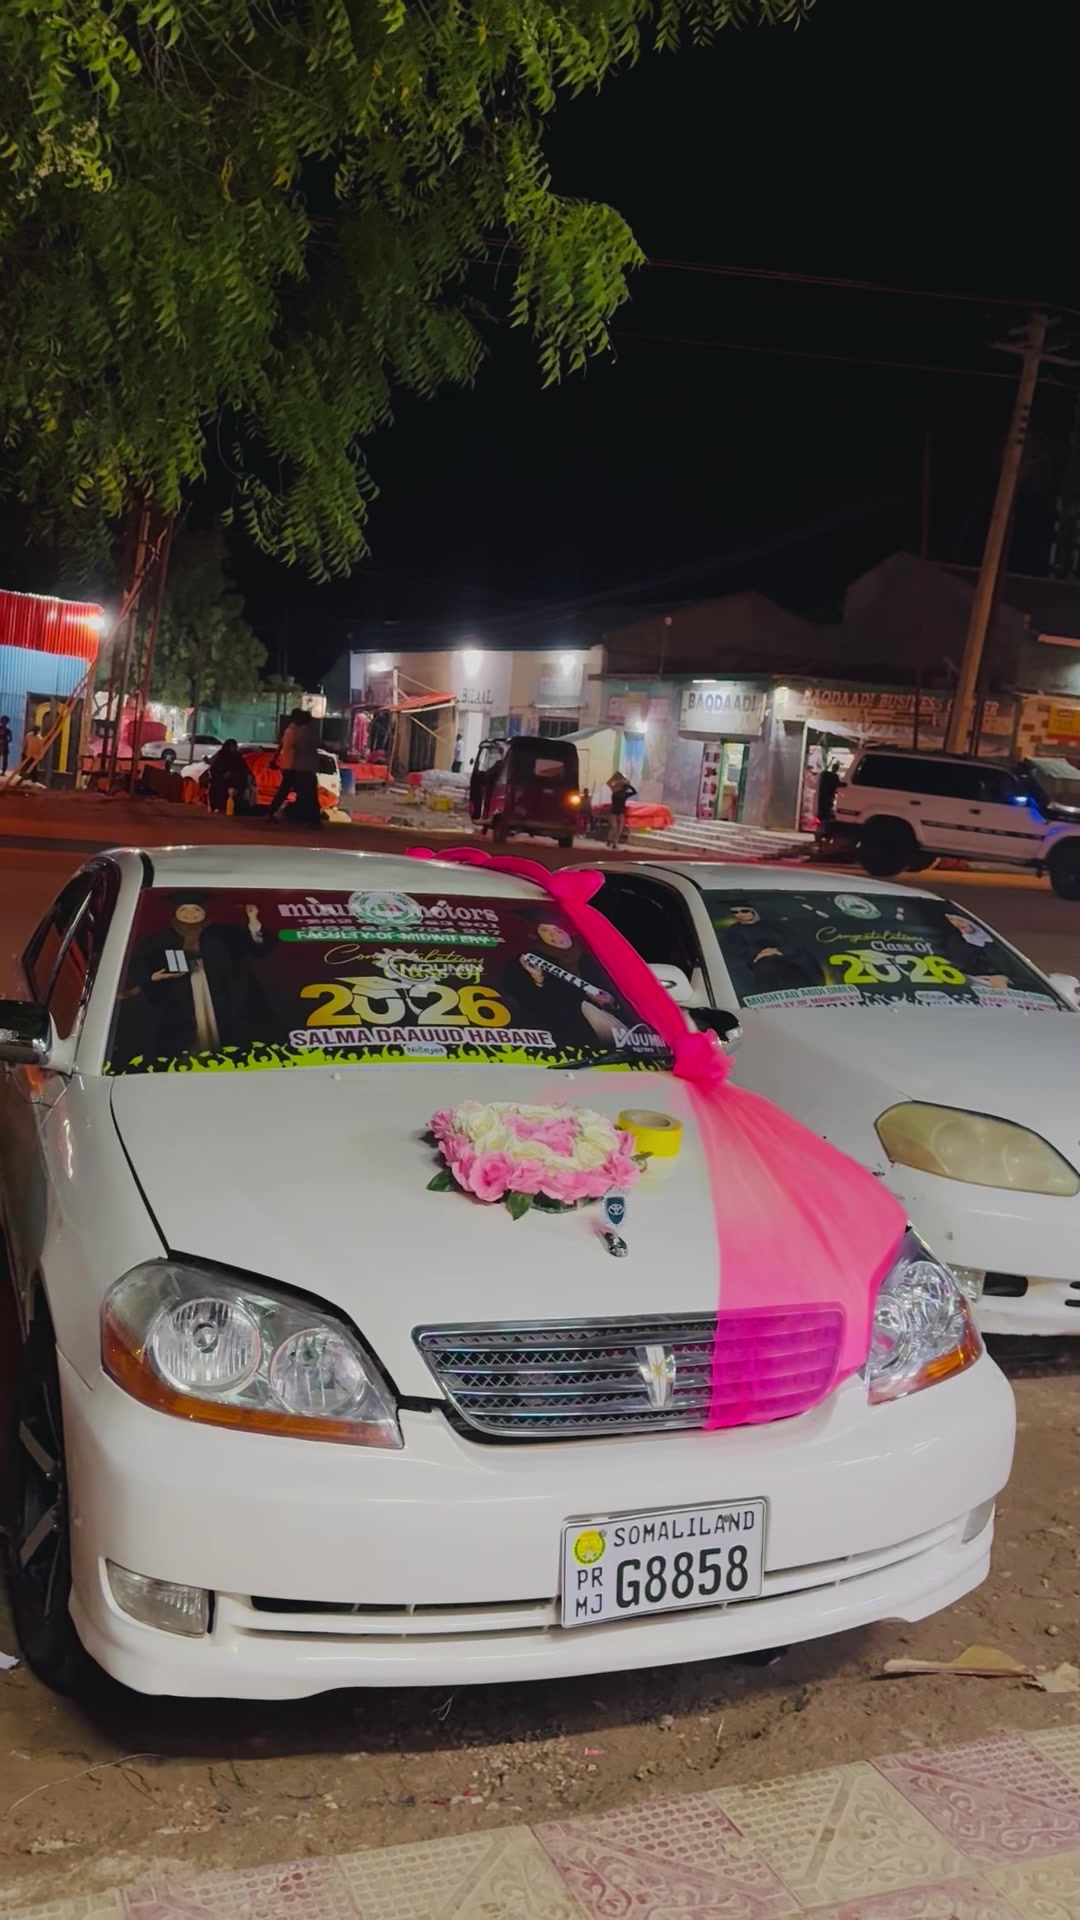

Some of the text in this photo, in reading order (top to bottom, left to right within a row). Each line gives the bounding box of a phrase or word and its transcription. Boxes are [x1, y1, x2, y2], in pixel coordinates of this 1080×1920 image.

[871, 941, 934, 956] Class Of
[829, 954, 967, 985] 2026
[299, 982, 512, 1027] 2026
[292, 1028, 550, 1046] SALMA DAAUUD HABANE
[613, 1510, 755, 1547] SOMALILAND
[576, 1566, 604, 1591] PR
[615, 1544, 748, 1609] G8858
[574, 1593, 604, 1618] MJ
